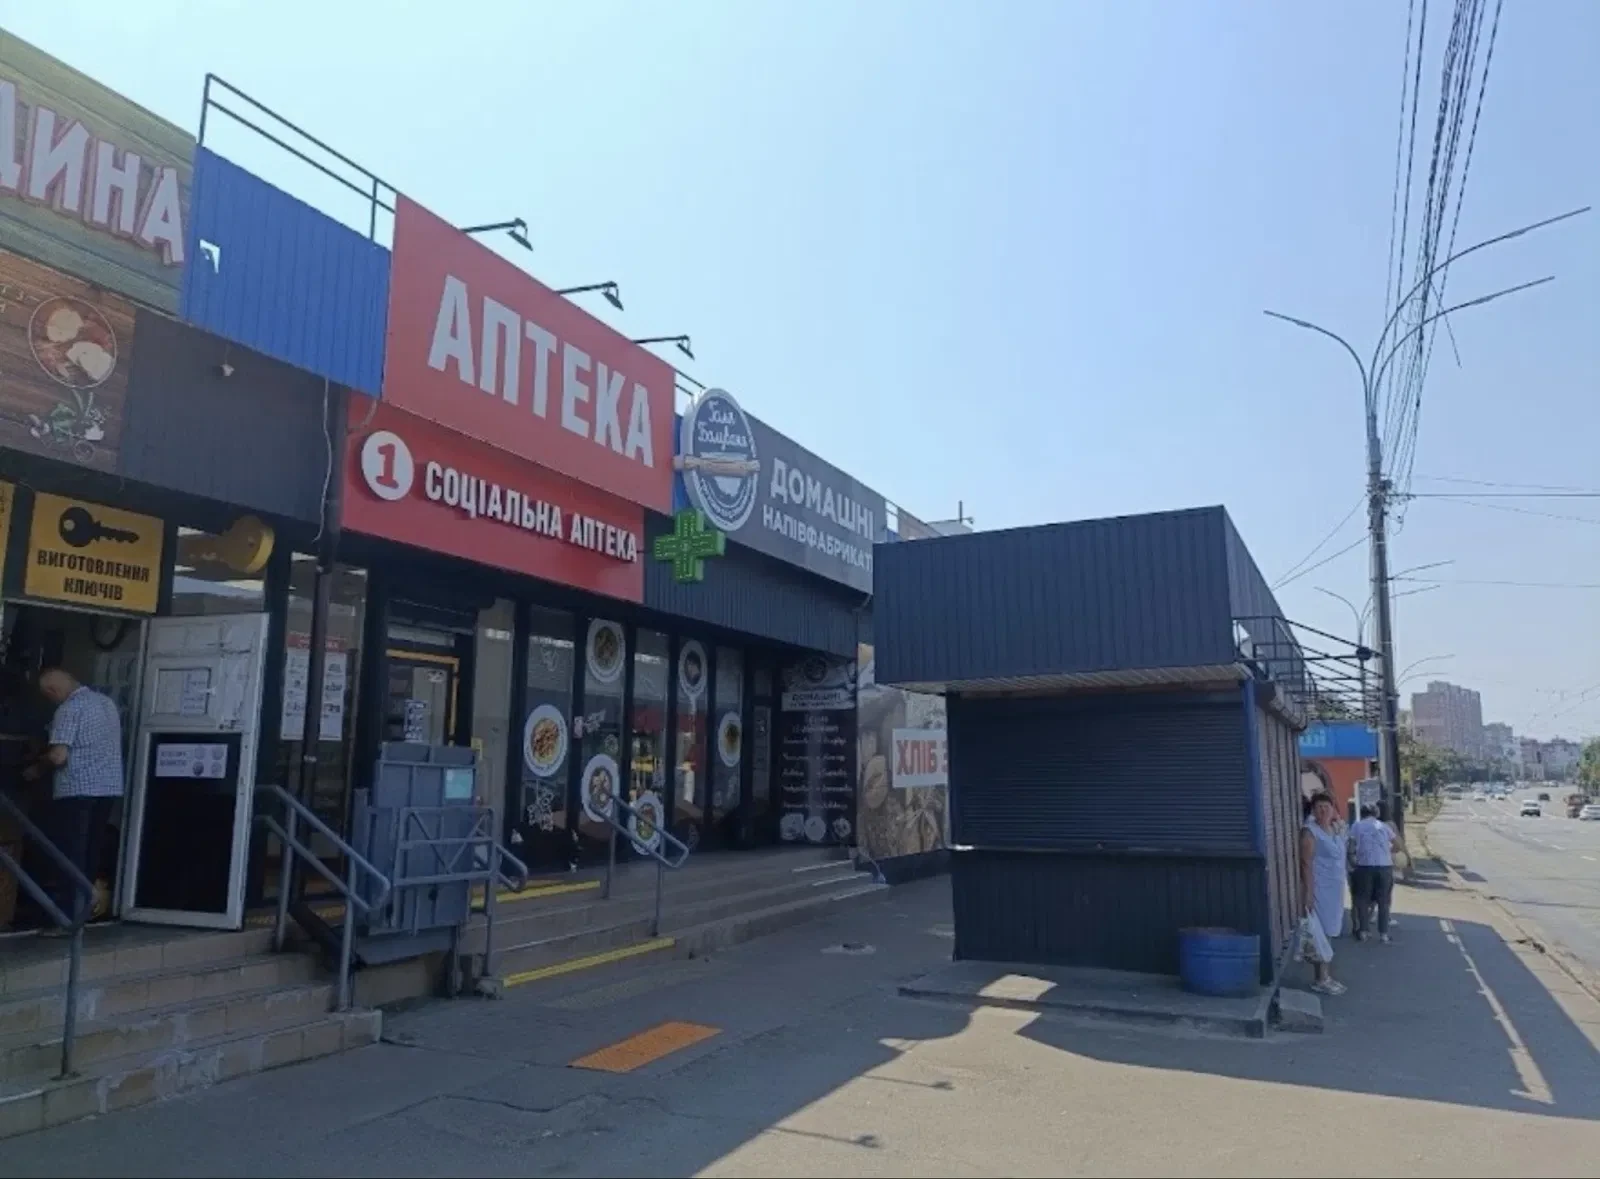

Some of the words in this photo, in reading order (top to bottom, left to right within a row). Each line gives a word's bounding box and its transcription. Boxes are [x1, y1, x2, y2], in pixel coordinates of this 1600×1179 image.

[428, 274, 654, 469] АПТЕКА
[424, 461, 564, 540] СОЦІАЛЬНА
[570, 513, 638, 563] АПТЕКА
[769, 457, 874, 541] ДОМАШНІ
[37, 549, 151, 583] ВИГОТОВЛЕННЯ
[63, 577, 124, 601] КЛЮЧІВ
[896, 739, 938, 775] ХЛІБ
